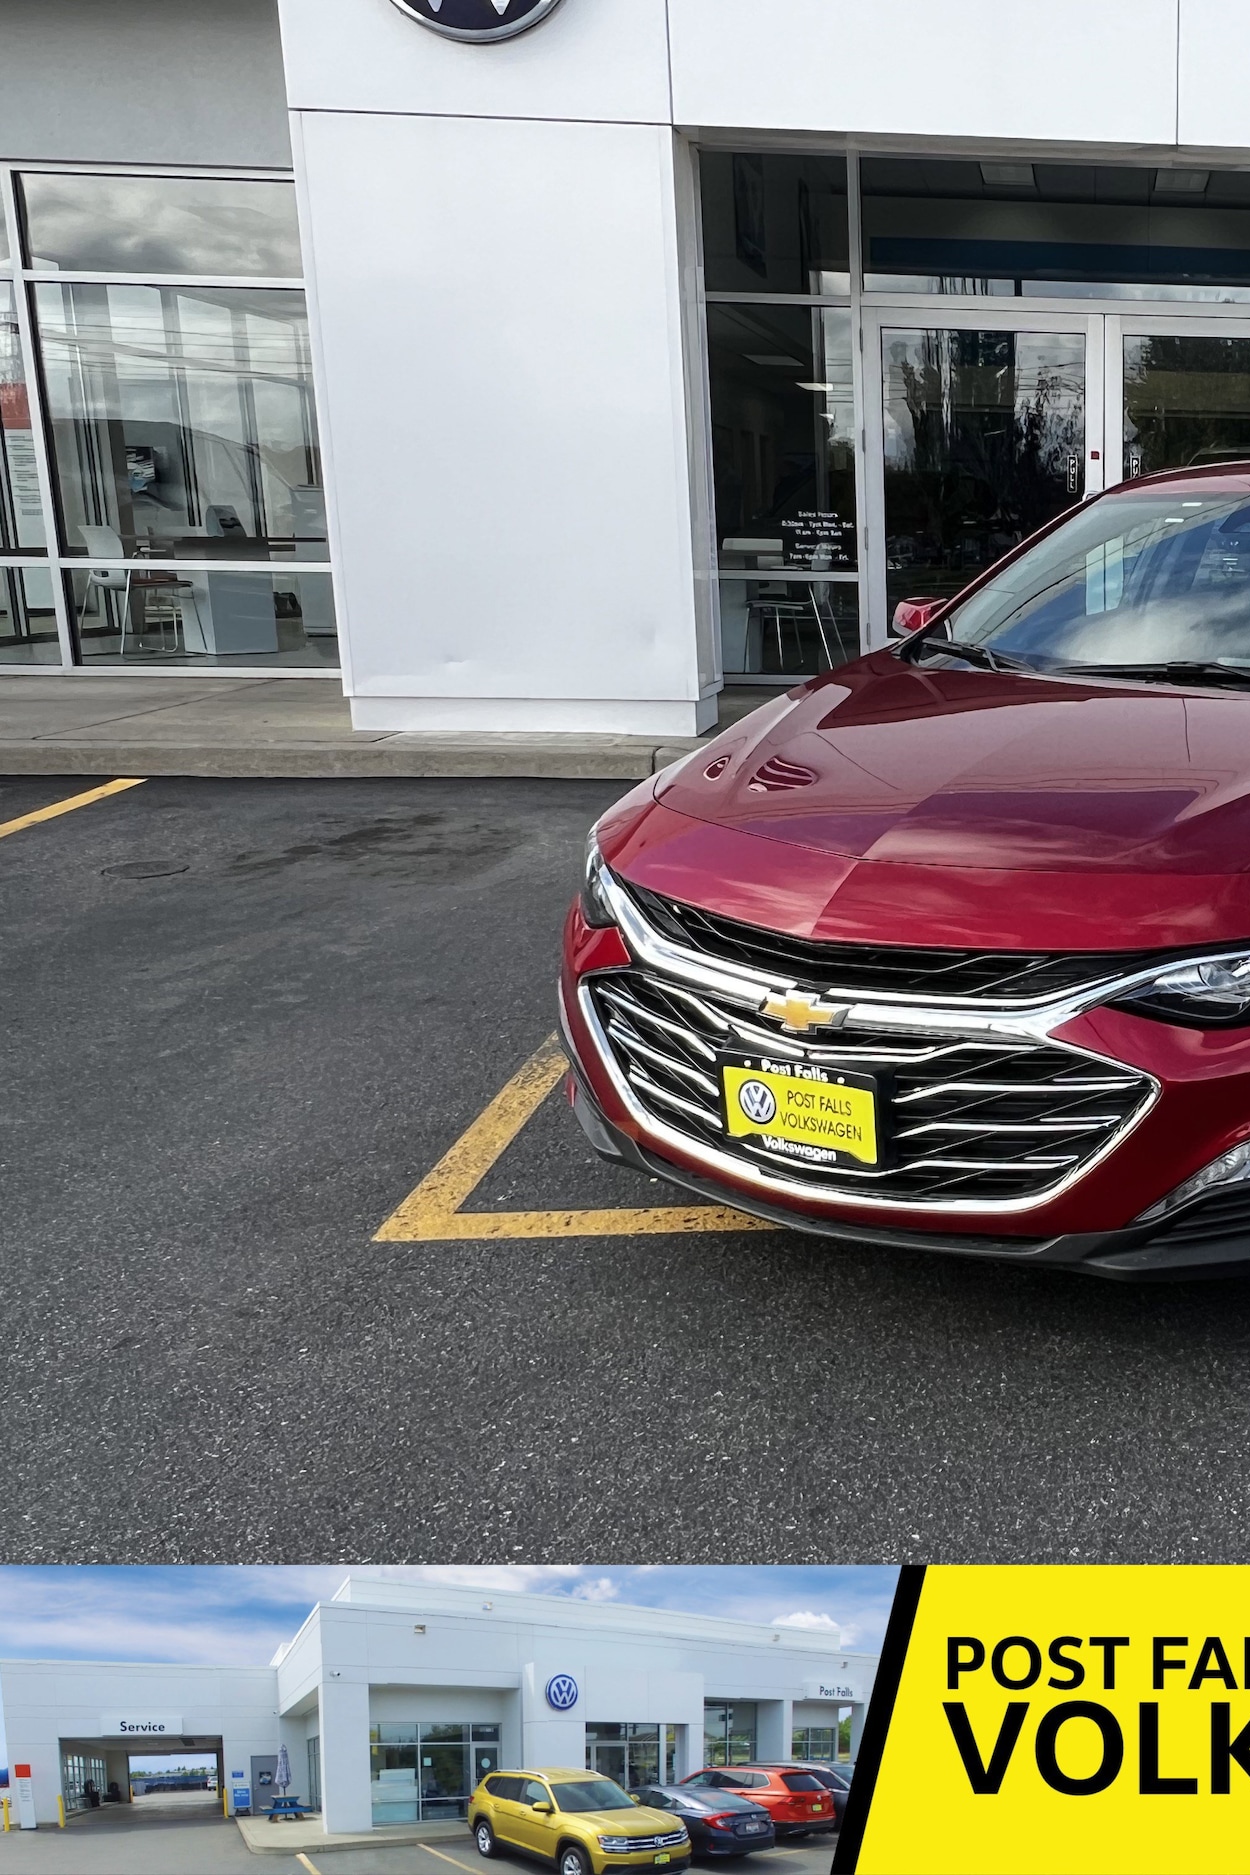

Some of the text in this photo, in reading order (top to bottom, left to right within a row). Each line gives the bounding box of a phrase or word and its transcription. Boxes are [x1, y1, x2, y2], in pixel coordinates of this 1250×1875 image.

[761, 1058, 829, 1083] Post Falls
[787, 1090, 852, 1116] POST FALLS
[780, 1112, 862, 1141] VOLKSWAGEN
[761, 1134, 837, 1161] Volkswagen
